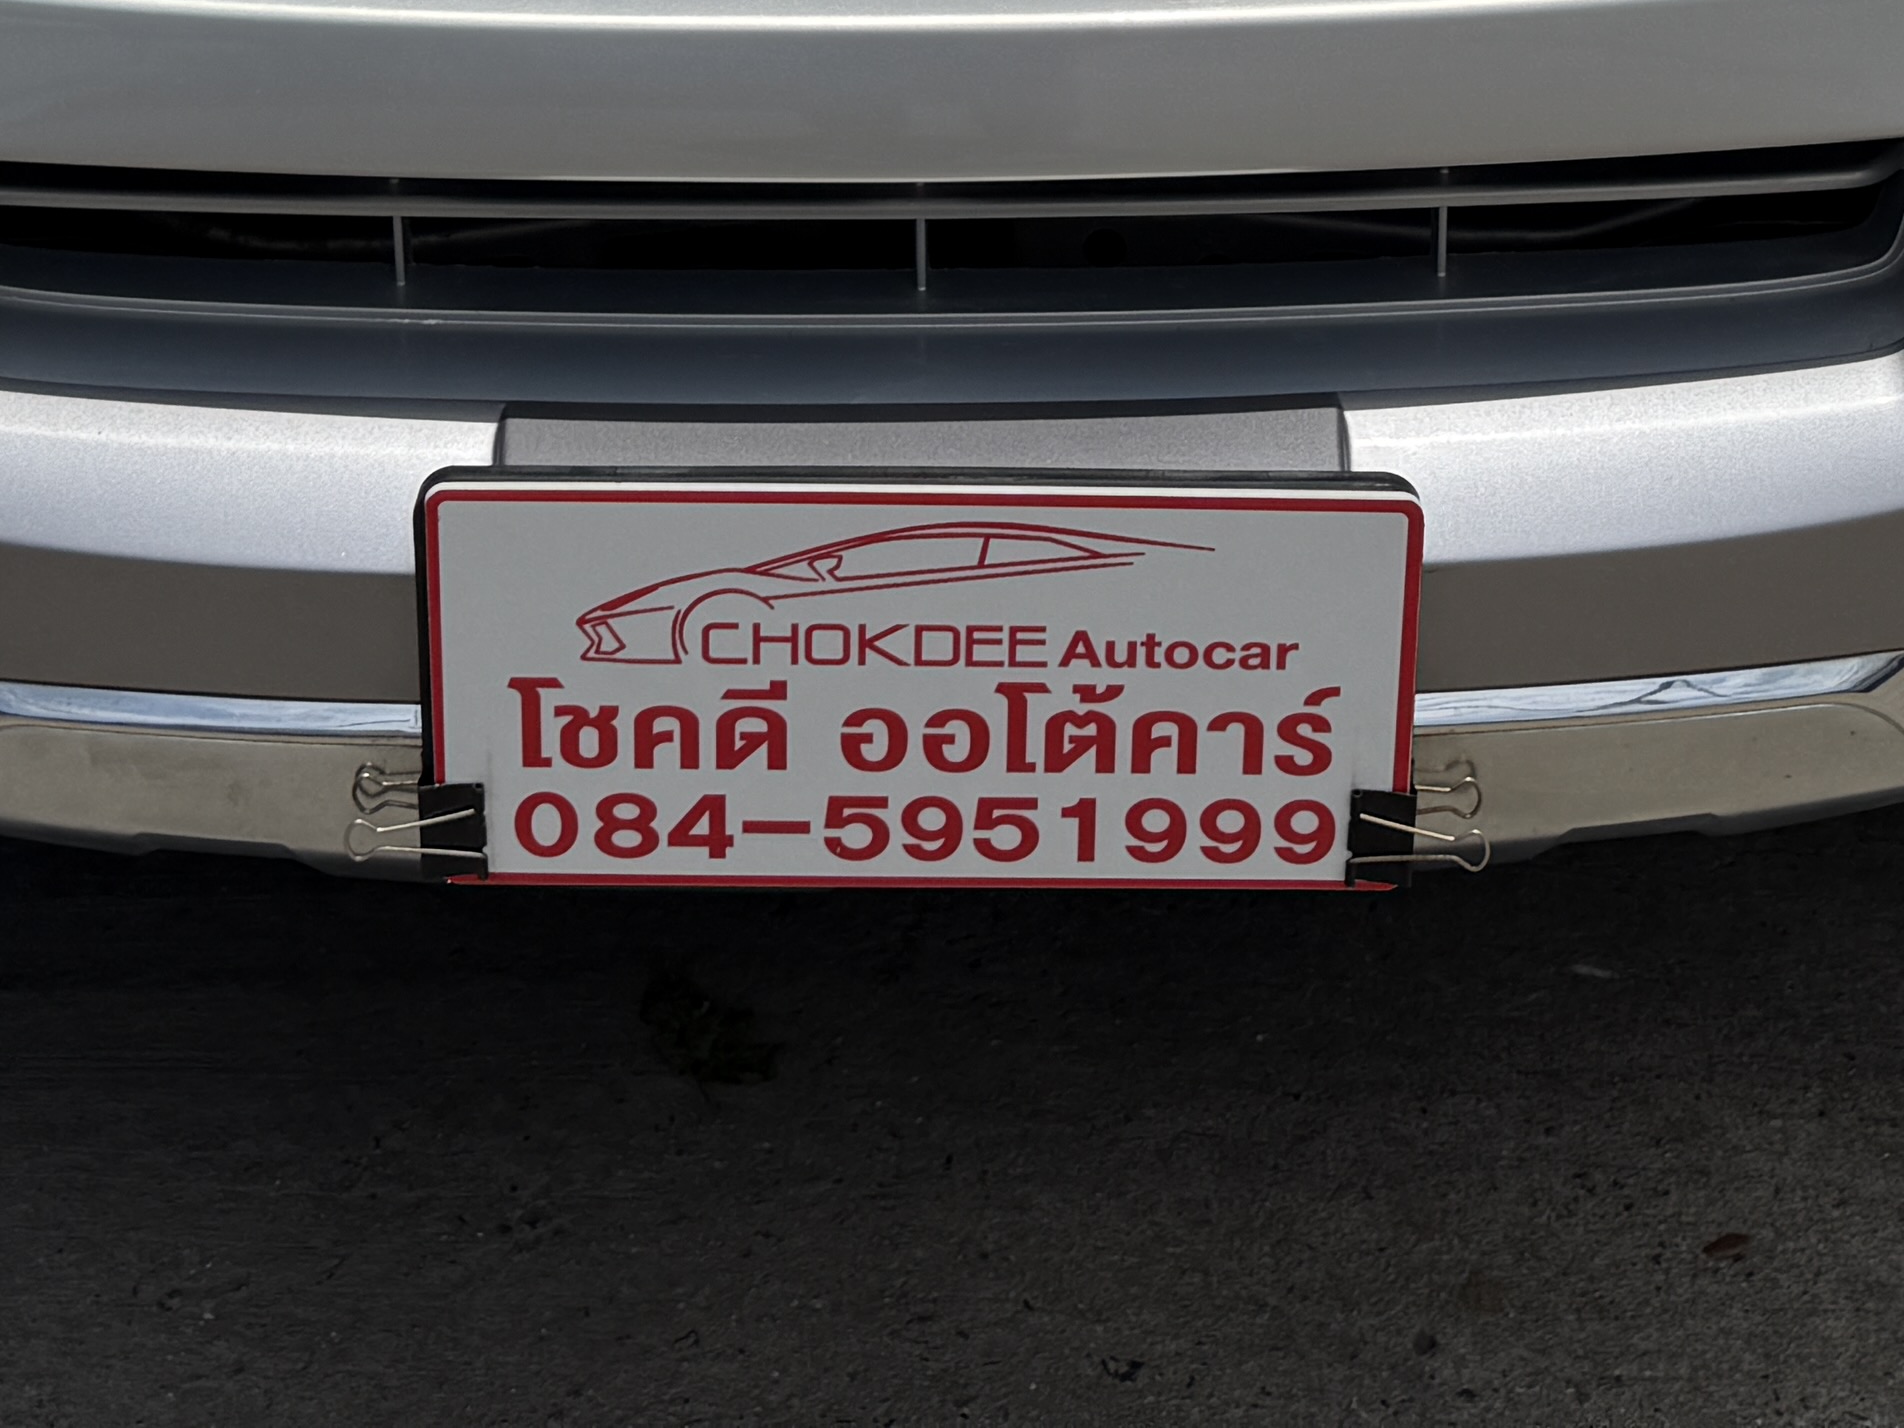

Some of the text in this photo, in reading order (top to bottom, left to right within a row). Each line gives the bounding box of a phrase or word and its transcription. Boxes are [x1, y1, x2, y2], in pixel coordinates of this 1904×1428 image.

[701, 622, 1300, 671] CHOKDEE Autocar
[507, 676, 1342, 778] โชคดี ออโต้คาร์
[514, 791, 1337, 865] 084-5951999
